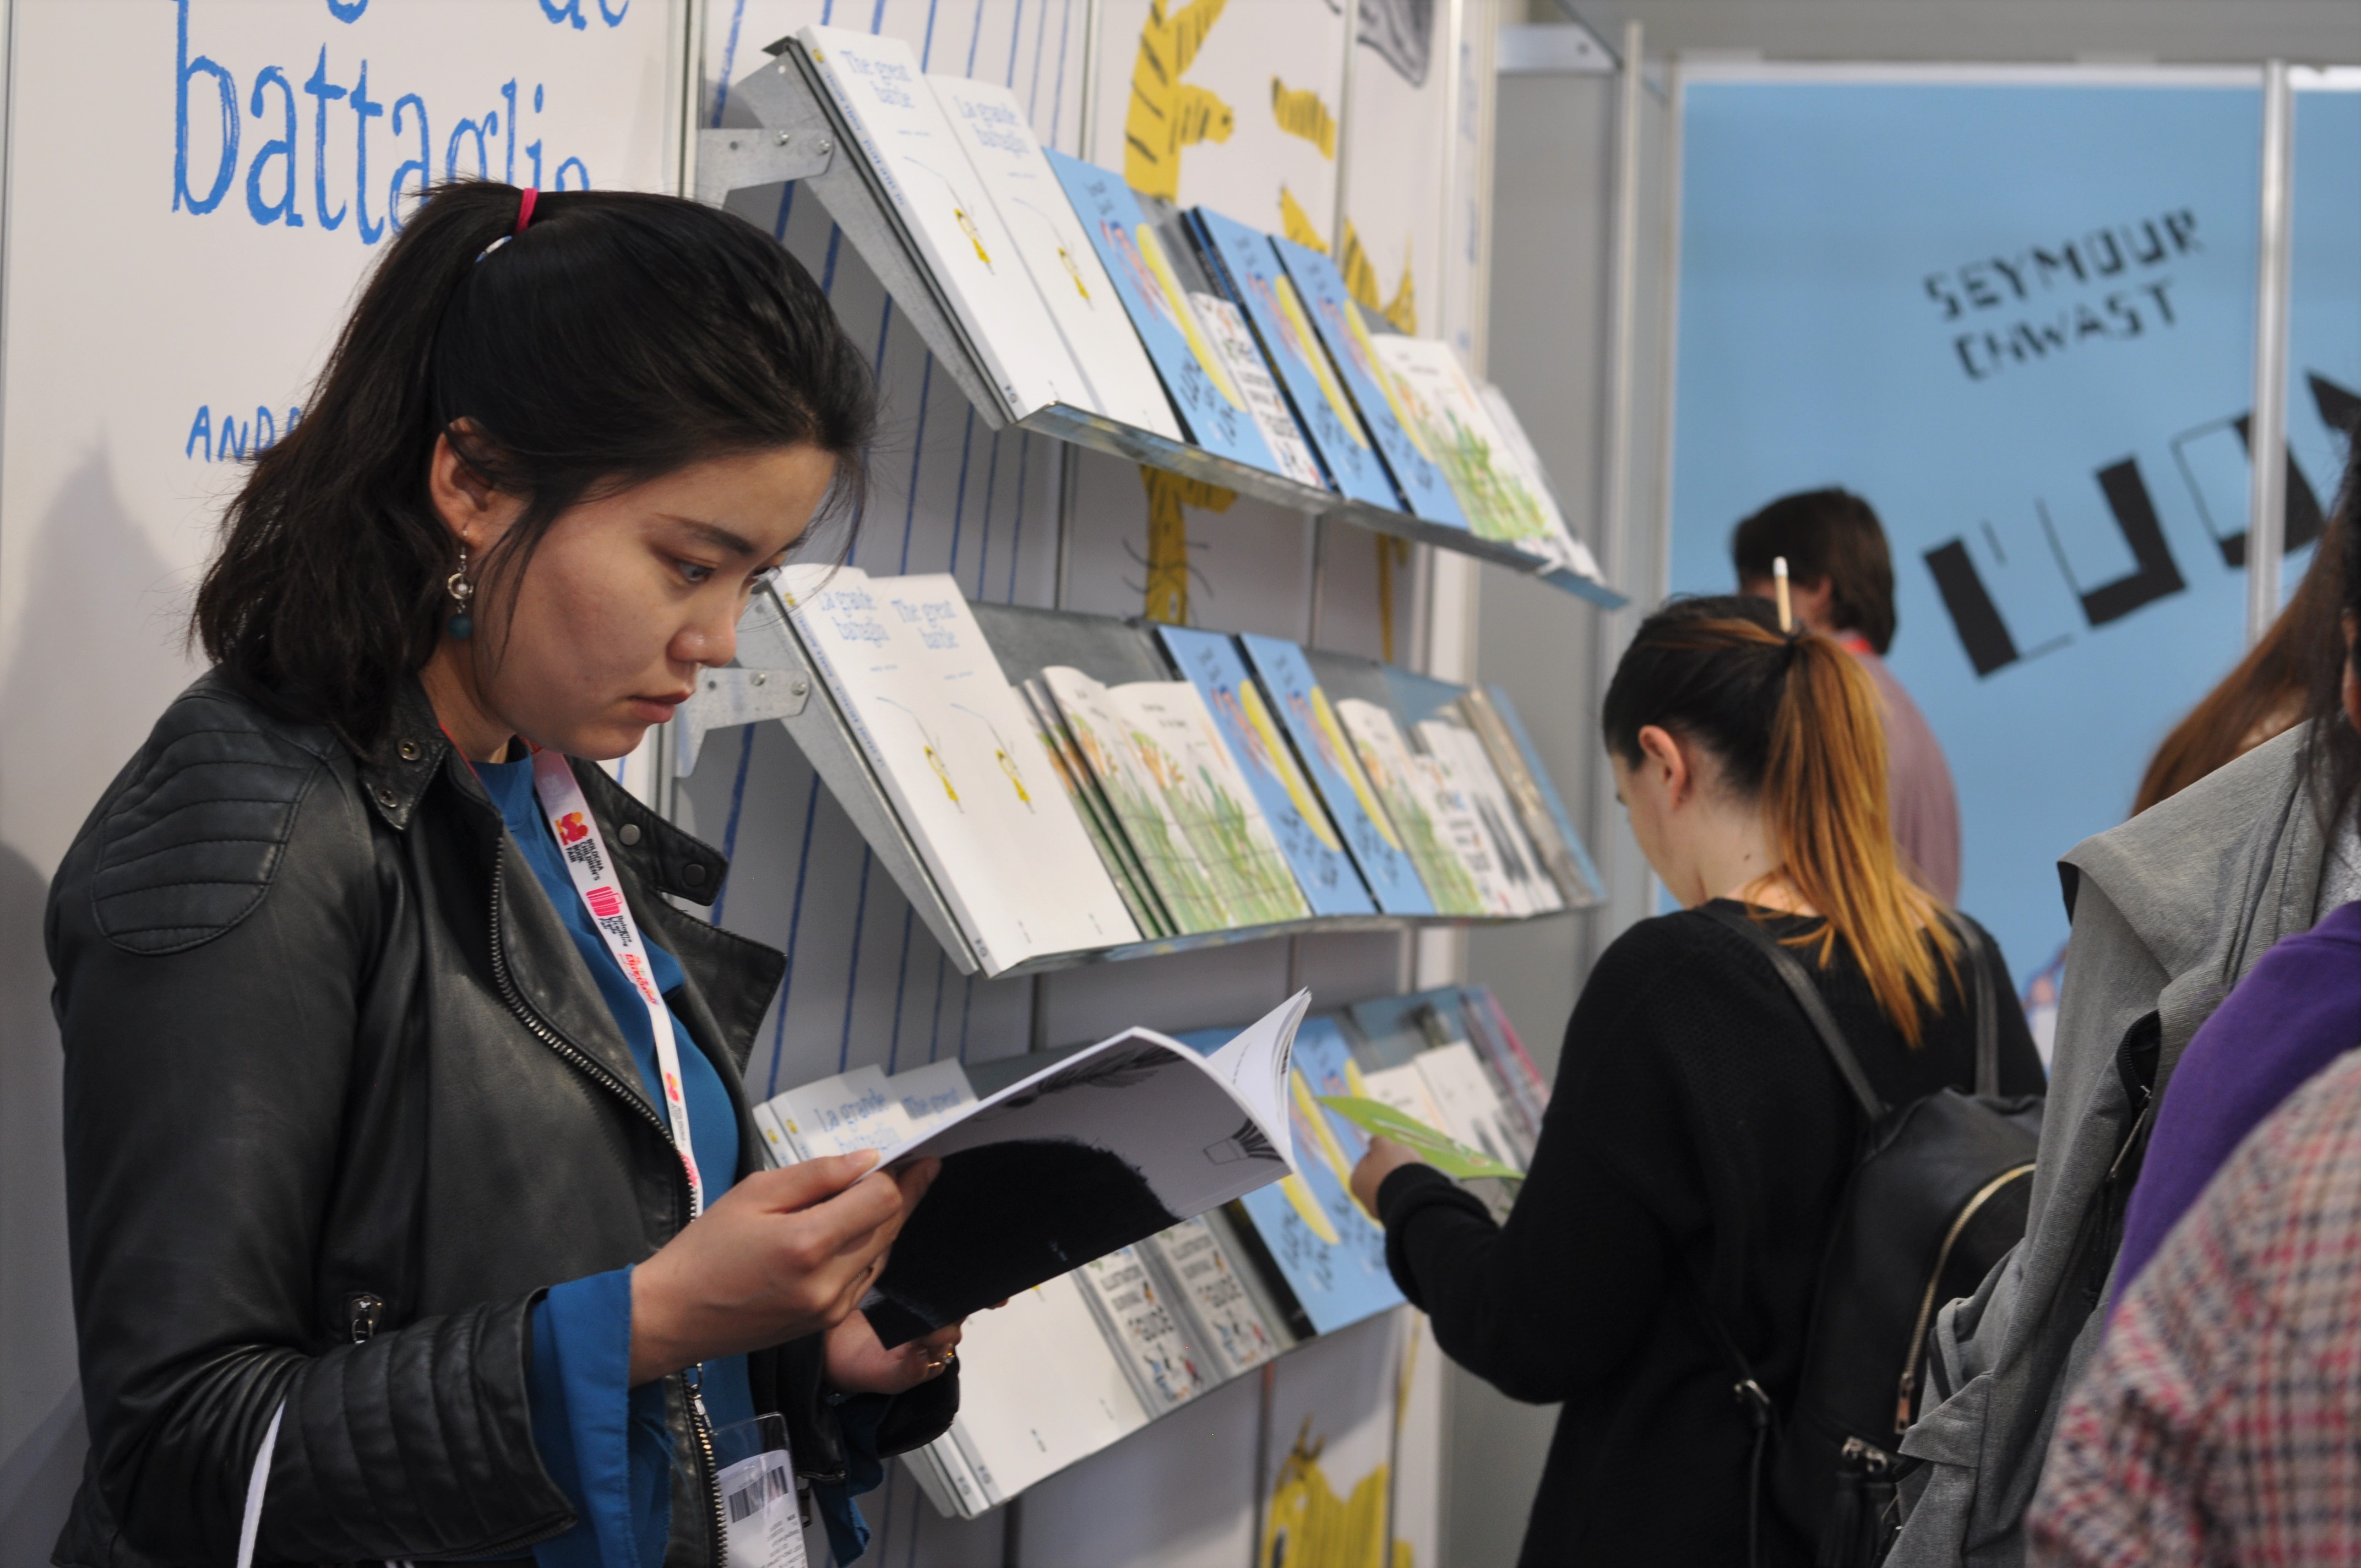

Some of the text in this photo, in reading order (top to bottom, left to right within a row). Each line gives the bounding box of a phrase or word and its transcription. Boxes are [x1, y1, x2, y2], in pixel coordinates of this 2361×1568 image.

[1923, 207, 2204, 322] SEYMOUR
[1954, 278, 2176, 381] CHWAST
[565, 847, 577, 863] FAIR
[573, 844, 585, 863] BOOK
[579, 841, 600, 881] CHILDREN'S
[586, 838, 604, 871] BOLOGNA
[813, 1108, 840, 1133] La
